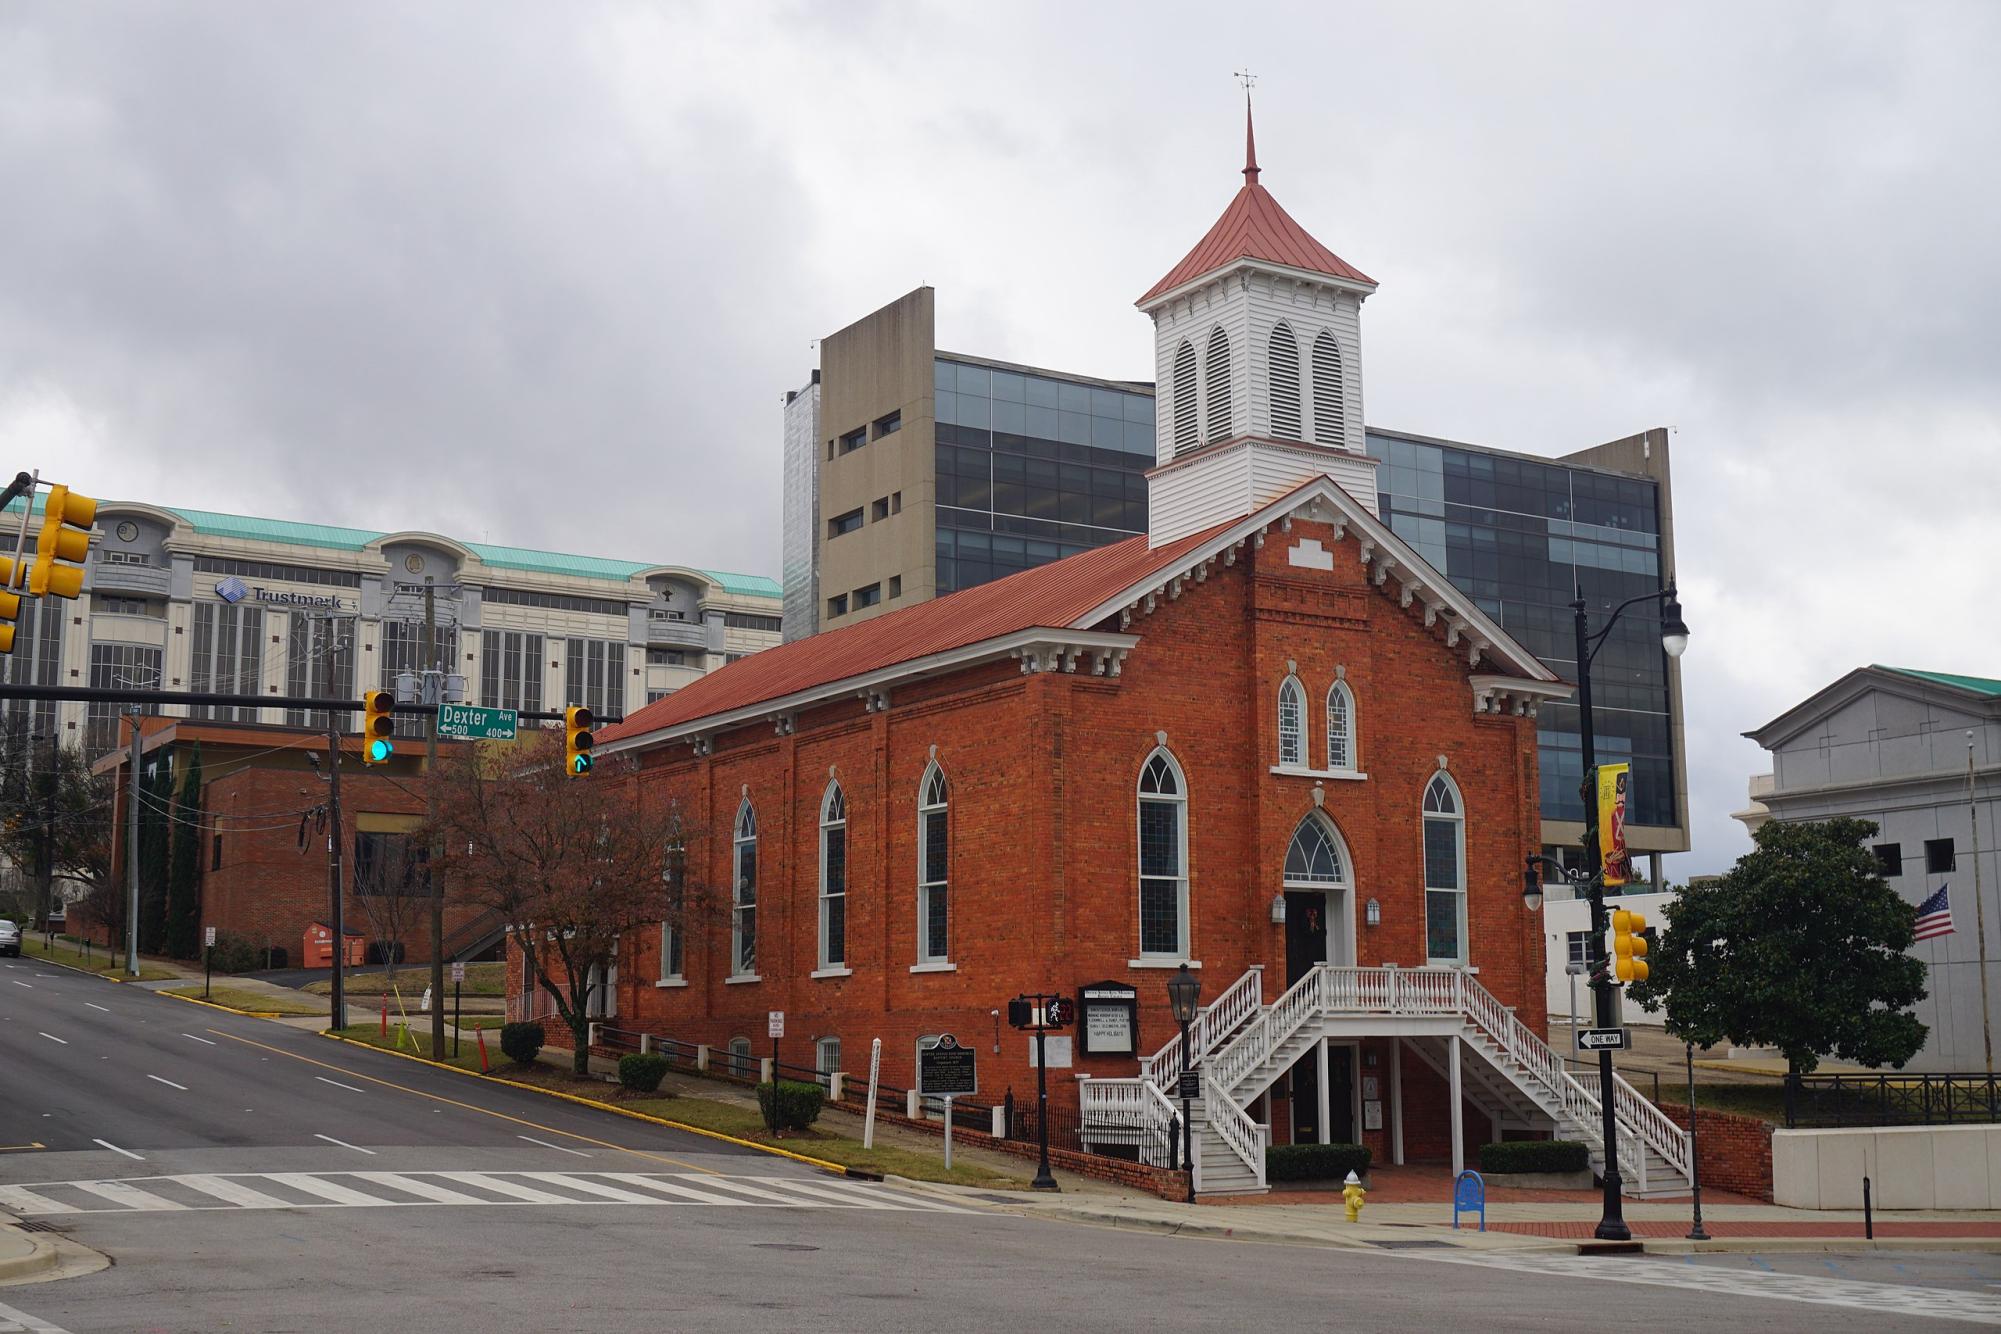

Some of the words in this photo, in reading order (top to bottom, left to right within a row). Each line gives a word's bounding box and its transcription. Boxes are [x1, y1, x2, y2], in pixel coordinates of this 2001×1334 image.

[253, 587, 341, 608] Trustmark
[443, 706, 487, 725] Dexter
[498, 712, 512, 721] Ave
[452, 726, 468, 735] 500
[487, 728, 502, 738] 400
[1591, 1035, 1604, 1044] ONE
[1606, 1035, 1618, 1043] WAY
